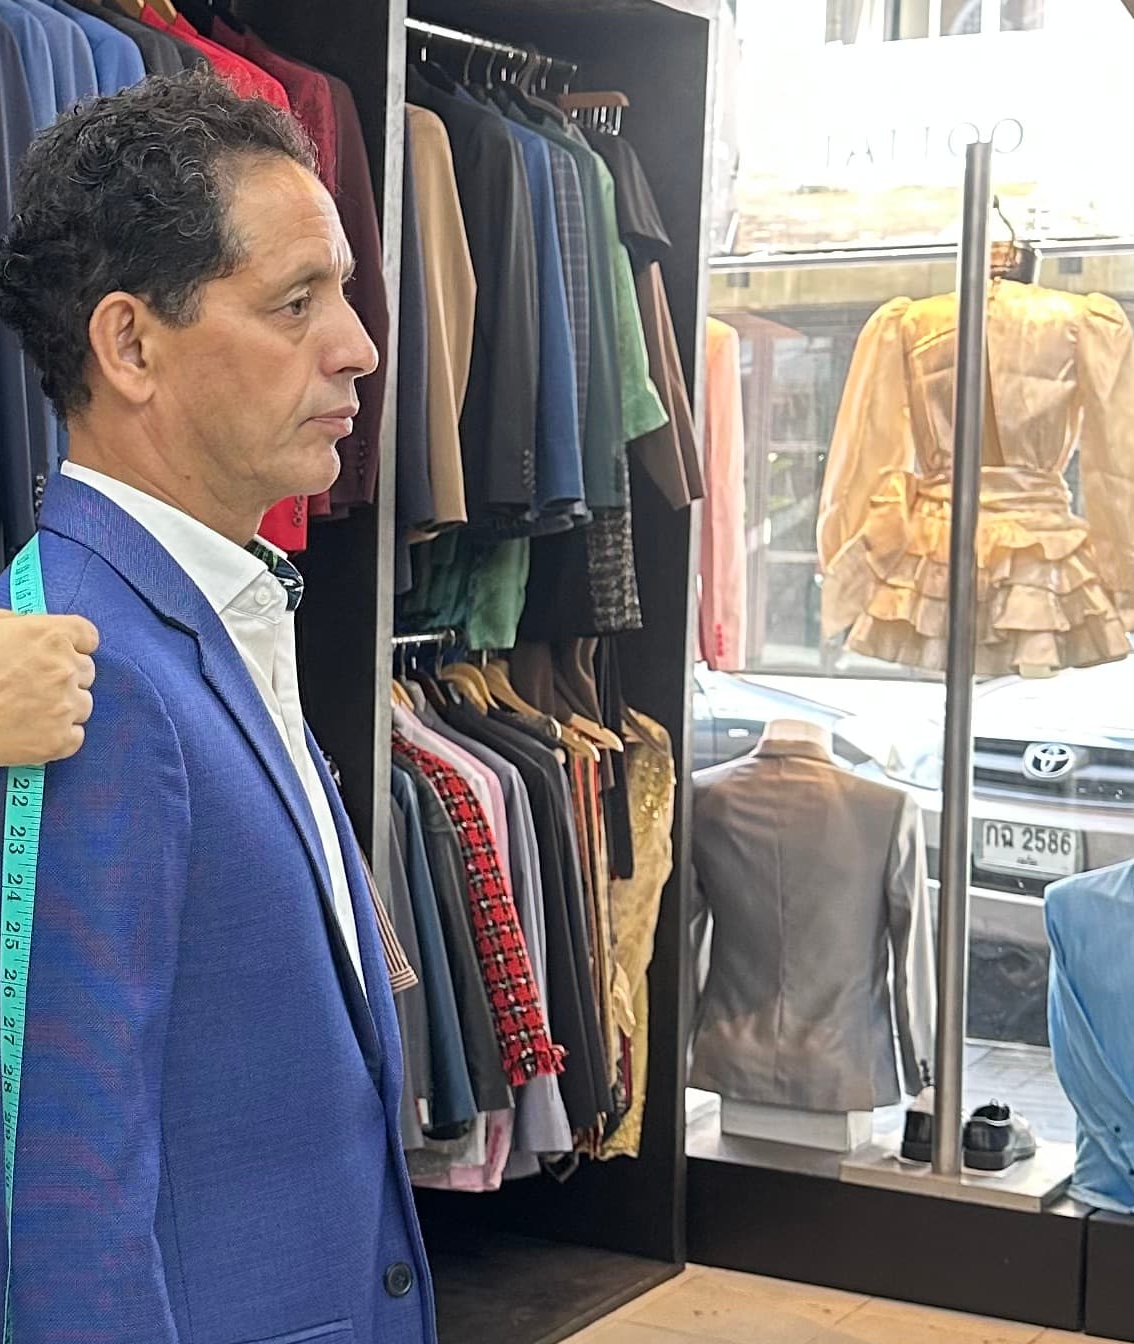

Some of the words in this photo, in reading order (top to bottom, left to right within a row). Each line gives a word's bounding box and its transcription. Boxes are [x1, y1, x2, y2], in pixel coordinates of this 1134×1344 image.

[11, 777, 30, 807] 22
[8, 825, 27, 855] 23
[1021, 826, 1072, 856] 2586
[6, 872, 24, 902] 24
[4, 920, 21, 950] 25
[3, 968, 18, 998] 26
[3, 1015, 16, 1046] 27
[3, 1063, 15, 1094] 28
